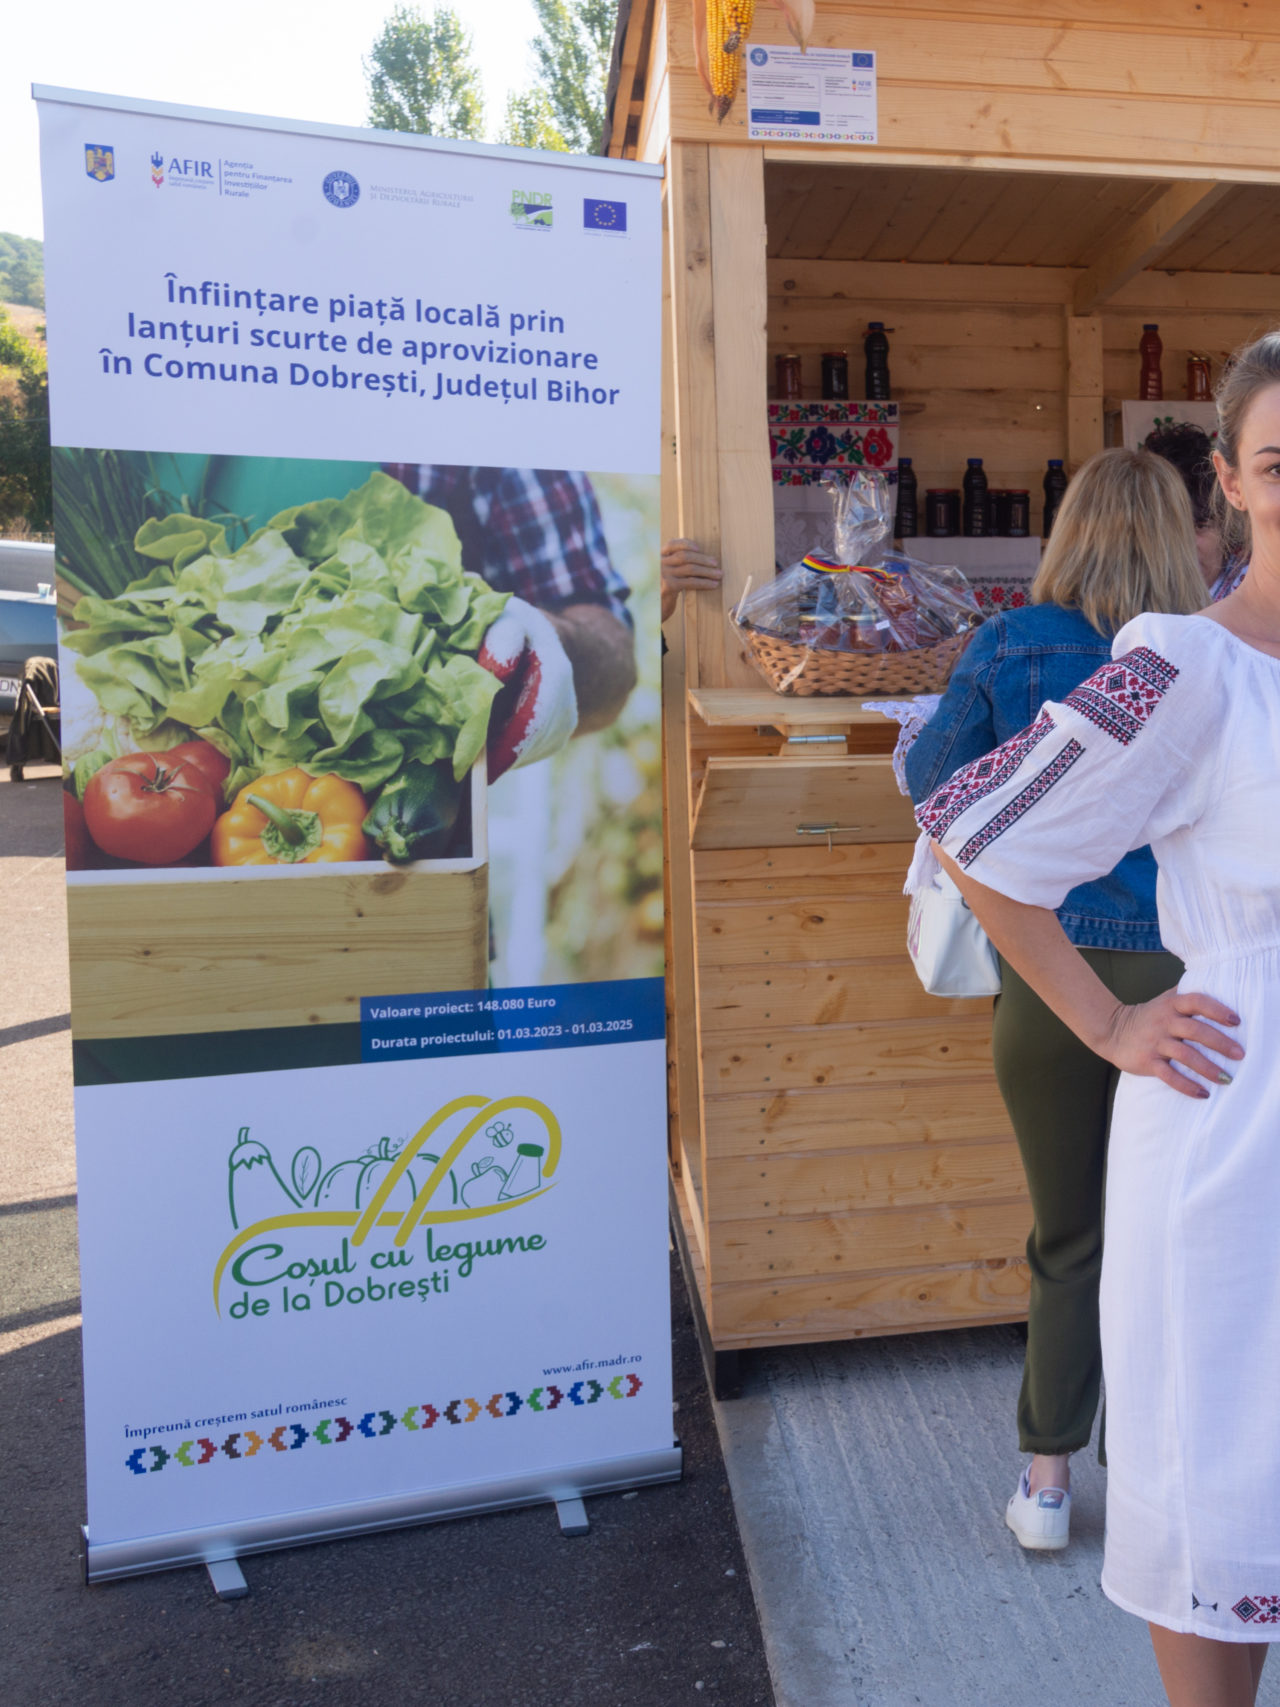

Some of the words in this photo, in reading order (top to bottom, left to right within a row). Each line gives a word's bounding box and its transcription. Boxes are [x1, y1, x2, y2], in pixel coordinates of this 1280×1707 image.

[168, 157, 214, 178] AFIR
[511, 189, 552, 207] PNDR
[163, 272, 319, 317] Înființare
[329, 293, 406, 323] piață
[415, 298, 500, 329] locală
[509, 309, 565, 337] prin
[128, 312, 240, 349] lanțuri
[250, 327, 347, 353] scurte
[357, 331, 393, 356] de
[402, 338, 599, 370] aprovizionare
[98, 347, 132, 375] în
[144, 352, 279, 385] Comuna
[289, 362, 427, 399] Dobrești,
[432, 371, 538, 405] Județul
[547, 379, 621, 405] Bihor
[370, 1006, 421, 1019] Valoare
[424, 1002, 474, 1018] proiect:
[477, 998, 525, 1012] 148.080
[527, 997, 556, 1009] Euro
[371, 1036, 417, 1049] Durata
[420, 1029, 495, 1048] proiectului:
[497, 1024, 562, 1040] 01.03.2023
[572, 1018, 633, 1035] 01.03.2025
[231, 1237, 357, 1287] Coșul
[370, 1249, 414, 1270] cu
[426, 1227, 548, 1278] legume
[229, 1290, 270, 1319] de
[283, 1286, 311, 1313] la
[542, 1354, 643, 1376] www.afir.madr.ro
[124, 1418, 192, 1439] Împreună
[194, 1412, 247, 1428] creștem
[250, 1402, 283, 1419] satul
[285, 1396, 348, 1414] românesc
